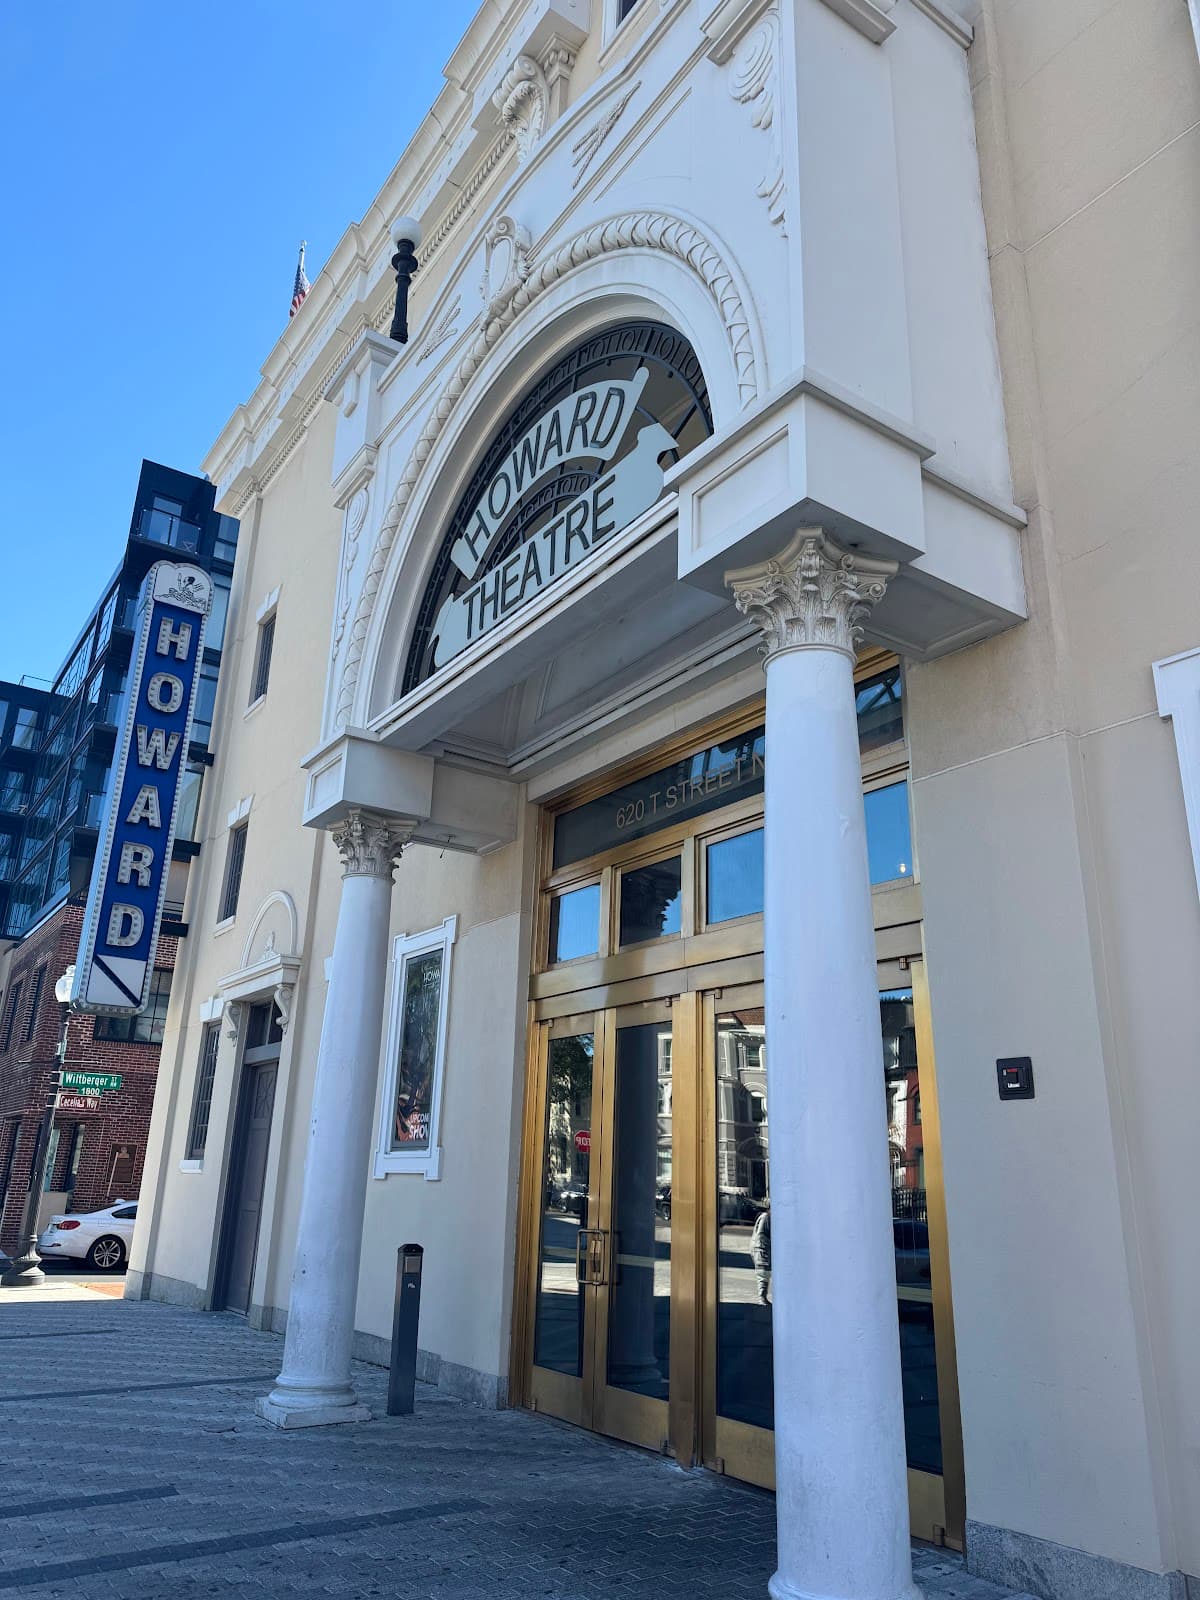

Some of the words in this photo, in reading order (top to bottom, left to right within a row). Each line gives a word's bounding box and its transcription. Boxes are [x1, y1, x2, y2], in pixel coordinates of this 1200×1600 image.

[462, 386, 625, 562] HOWARD
[462, 473, 616, 640] THEATRE
[105, 616, 193, 948] HOWARD
[616, 799, 644, 829] 620
[649, 791, 661, 815] T
[665, 757, 744, 809] STREET
[751, 752, 765, 776] N
[423, 969, 440, 982] HOWA
[65, 1072, 109, 1087] Wiltberger
[81, 1087, 100, 1095] 1800
[86, 1097, 98, 1110] Way
